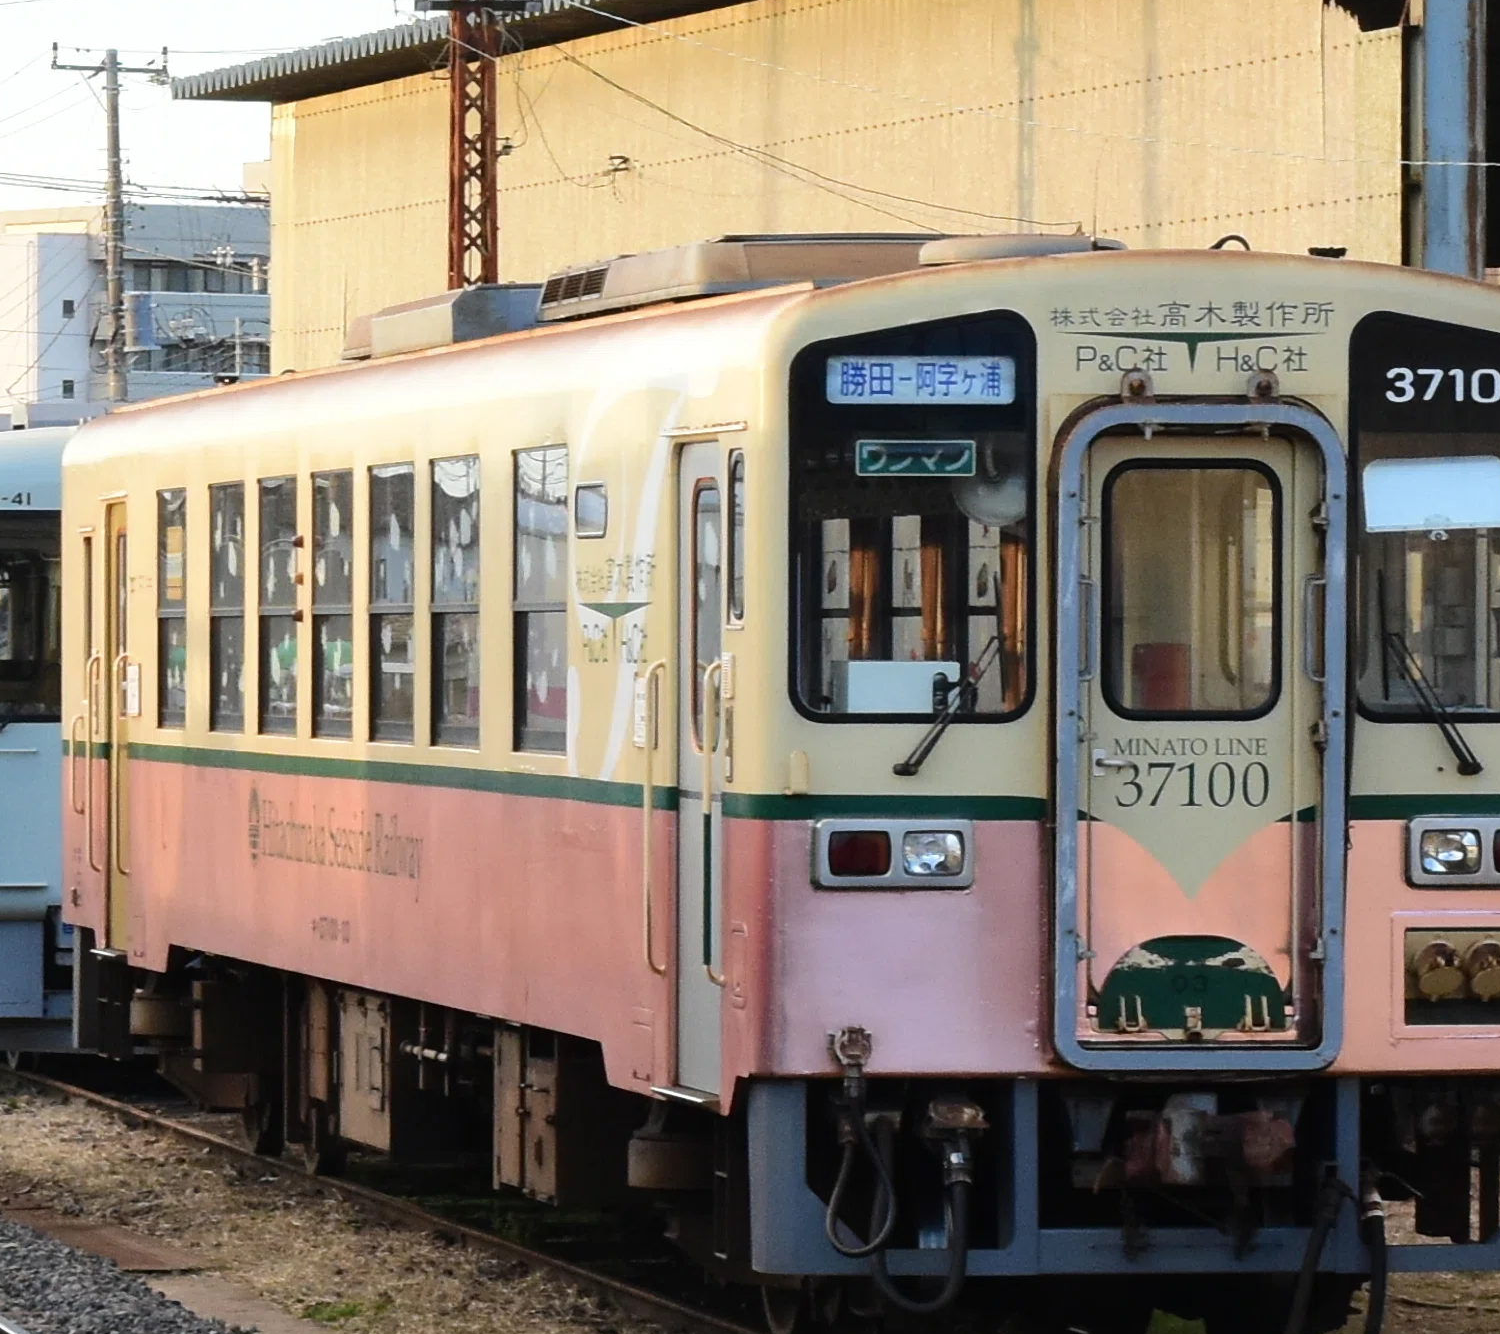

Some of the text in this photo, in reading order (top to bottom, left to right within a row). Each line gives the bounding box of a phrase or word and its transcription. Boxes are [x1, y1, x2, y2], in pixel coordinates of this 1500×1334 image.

[1049, 300, 1335, 328] 株式会社高木製作所
[1075, 345, 1168, 373] P&C社
[1216, 345, 1309, 373] H&C社
[1113, 737, 1268, 756] MINATO LINE
[1115, 761, 1270, 808] 37100
